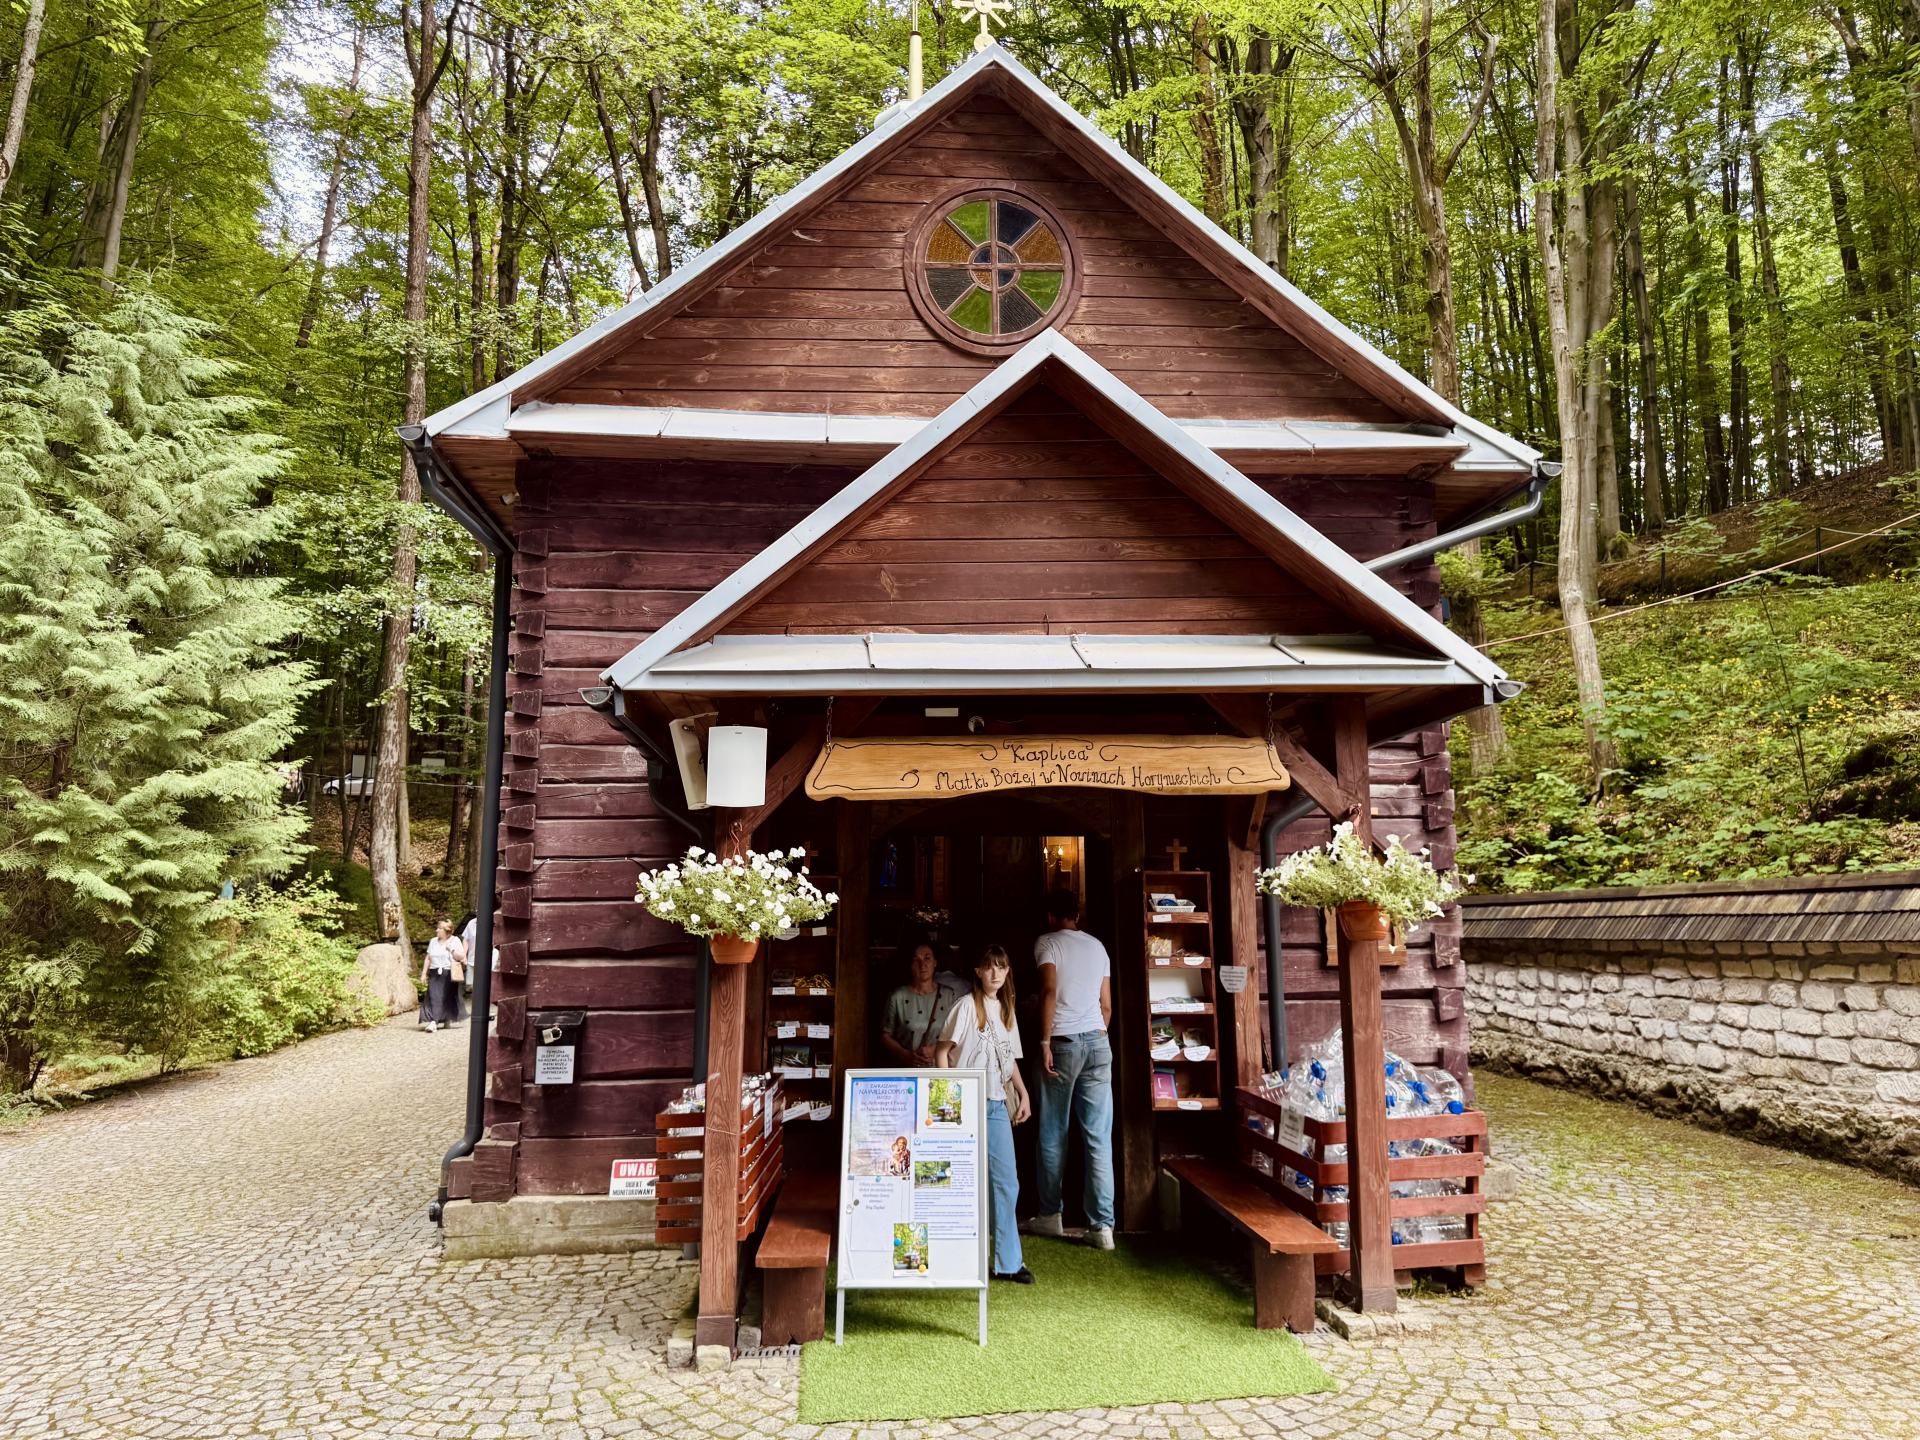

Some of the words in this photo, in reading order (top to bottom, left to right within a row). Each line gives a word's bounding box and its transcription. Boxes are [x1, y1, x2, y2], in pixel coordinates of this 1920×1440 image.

[1010, 743, 1089, 767] Kaplica
[934, 771, 988, 791] Matki
[1039, 770, 1056, 784] w
[1131, 765, 1221, 791] Horynieckich
